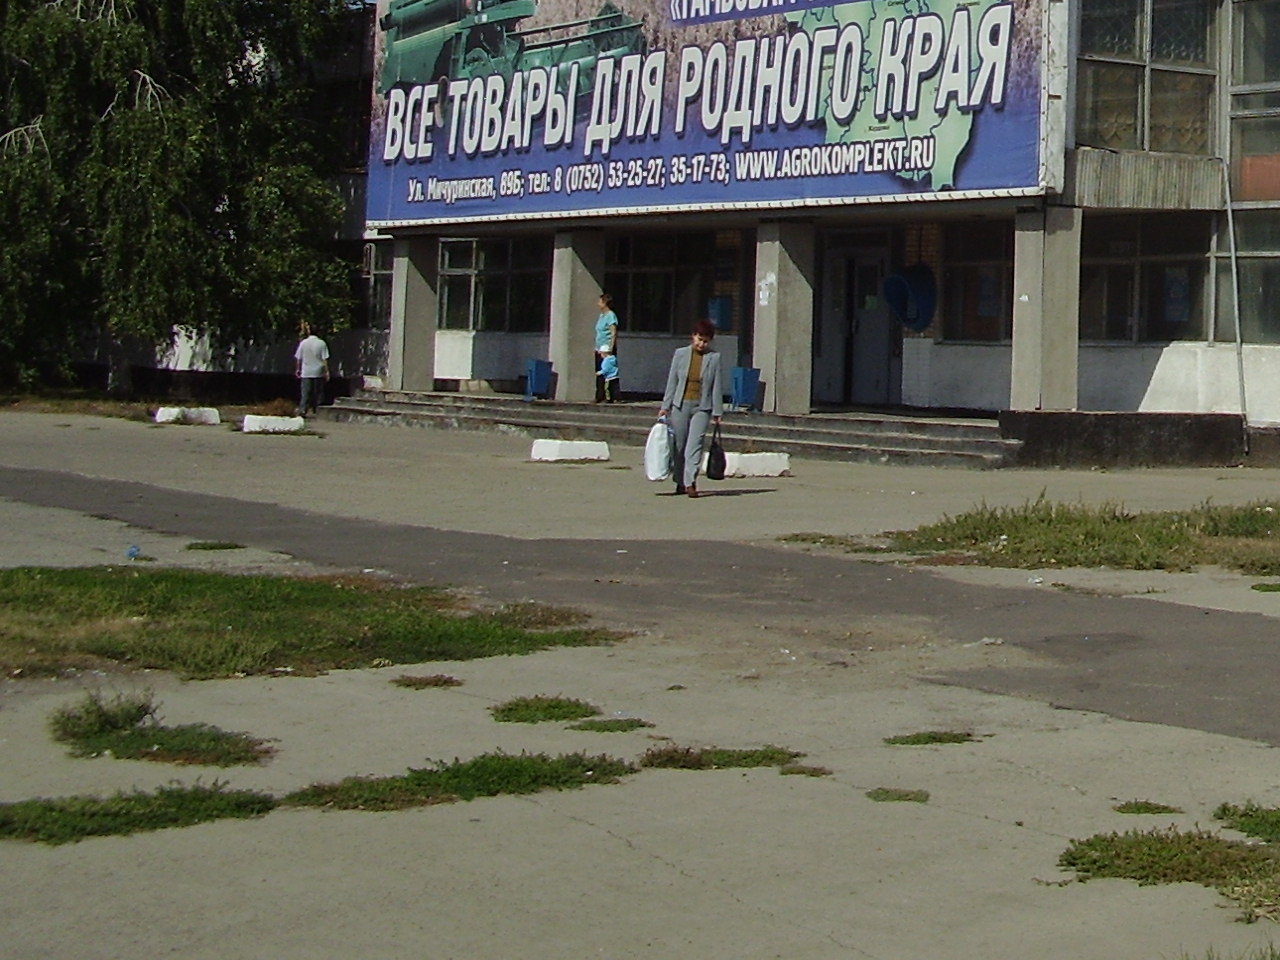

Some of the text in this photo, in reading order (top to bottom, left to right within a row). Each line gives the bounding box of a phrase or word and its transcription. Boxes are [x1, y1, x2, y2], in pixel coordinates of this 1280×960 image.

[383, 4, 1013, 162] ВСЕ ТОВАРЫ ДЛЯ РОДНОГО КРАЯ
[407, 178, 425, 202] Ул.
[427, 176, 496, 203] Мичуринская,
[528, 172, 551, 194] тел:
[554, 166, 562, 192] 8
[565, 162, 605, 195] (0752)
[608, 158, 666, 188] 53-25-27;
[670, 153, 730, 185] 35-17-73;
[735, 137, 935, 180] WWW.AGROKOMPLEKT.RU
